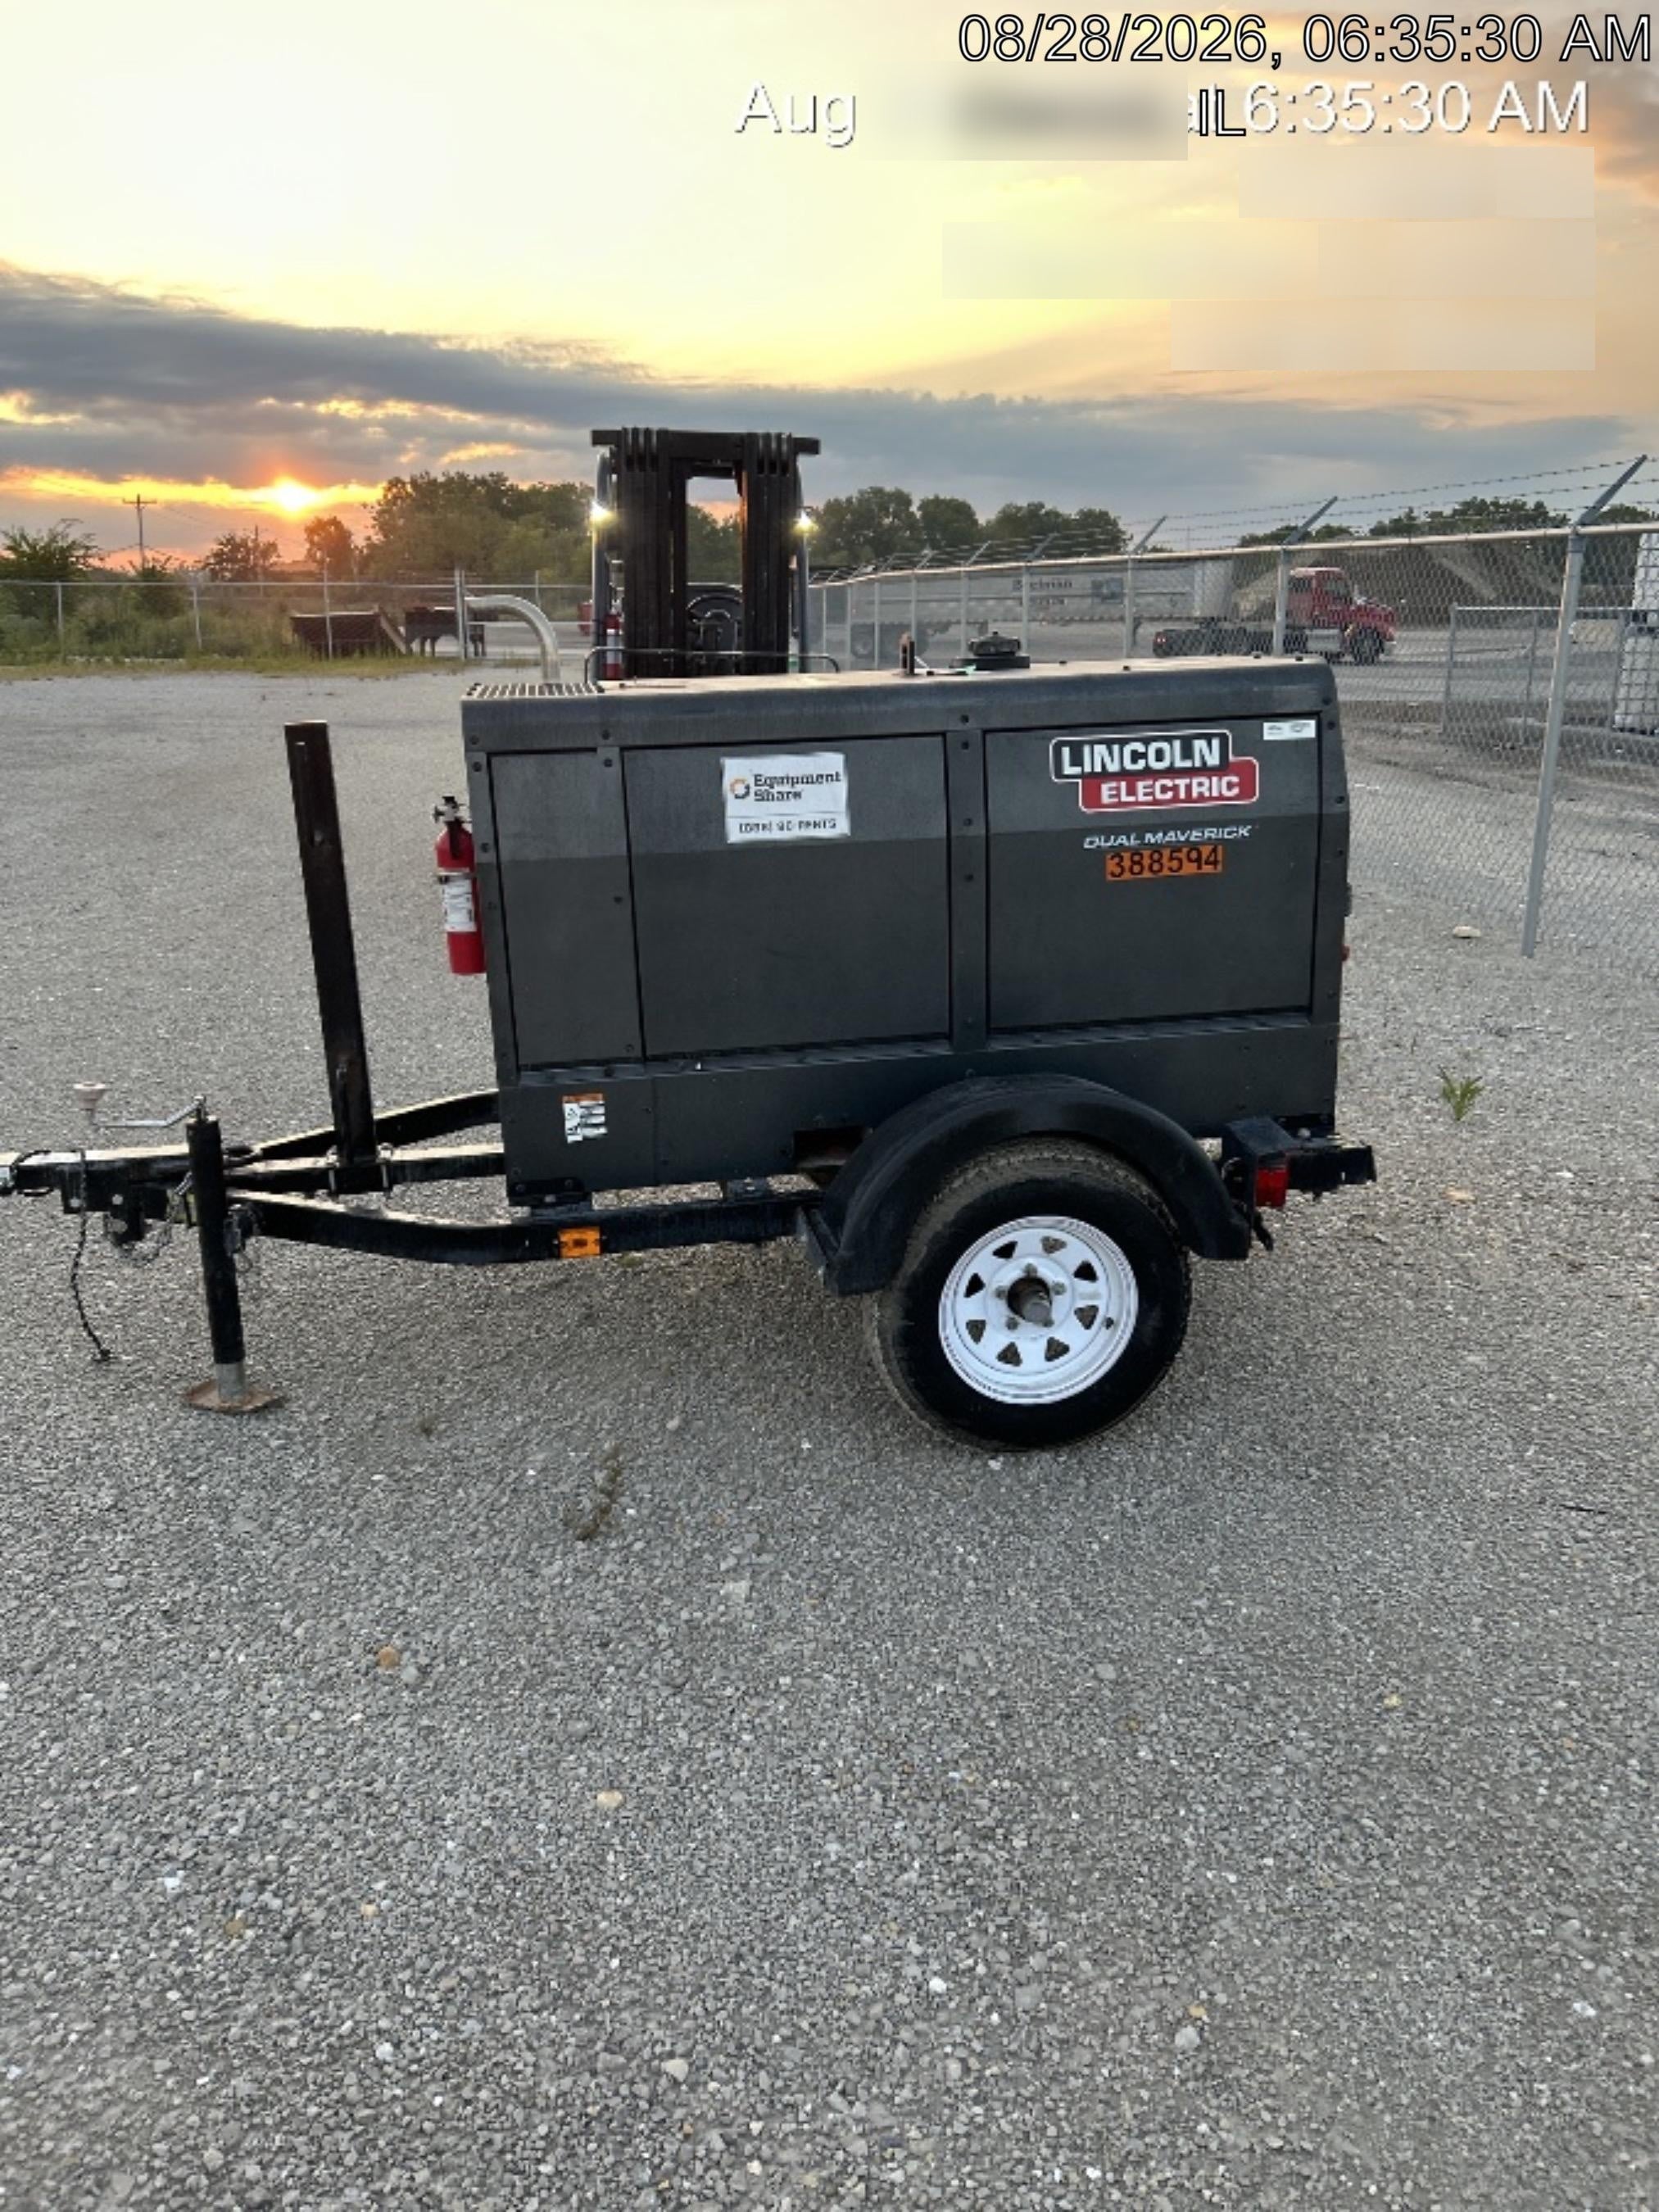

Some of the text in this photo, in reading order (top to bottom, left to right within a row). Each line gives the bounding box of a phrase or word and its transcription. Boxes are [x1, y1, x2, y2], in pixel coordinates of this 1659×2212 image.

[1062, 737, 1221, 775] LINCOLN
[754, 771, 841, 789] Equipment
[1100, 776, 1240, 805] ELECTRIC
[754, 789, 802, 802] Share
[1083, 825, 1252, 849] DUAL MAVERICK
[1109, 845, 1220, 877] 388594
